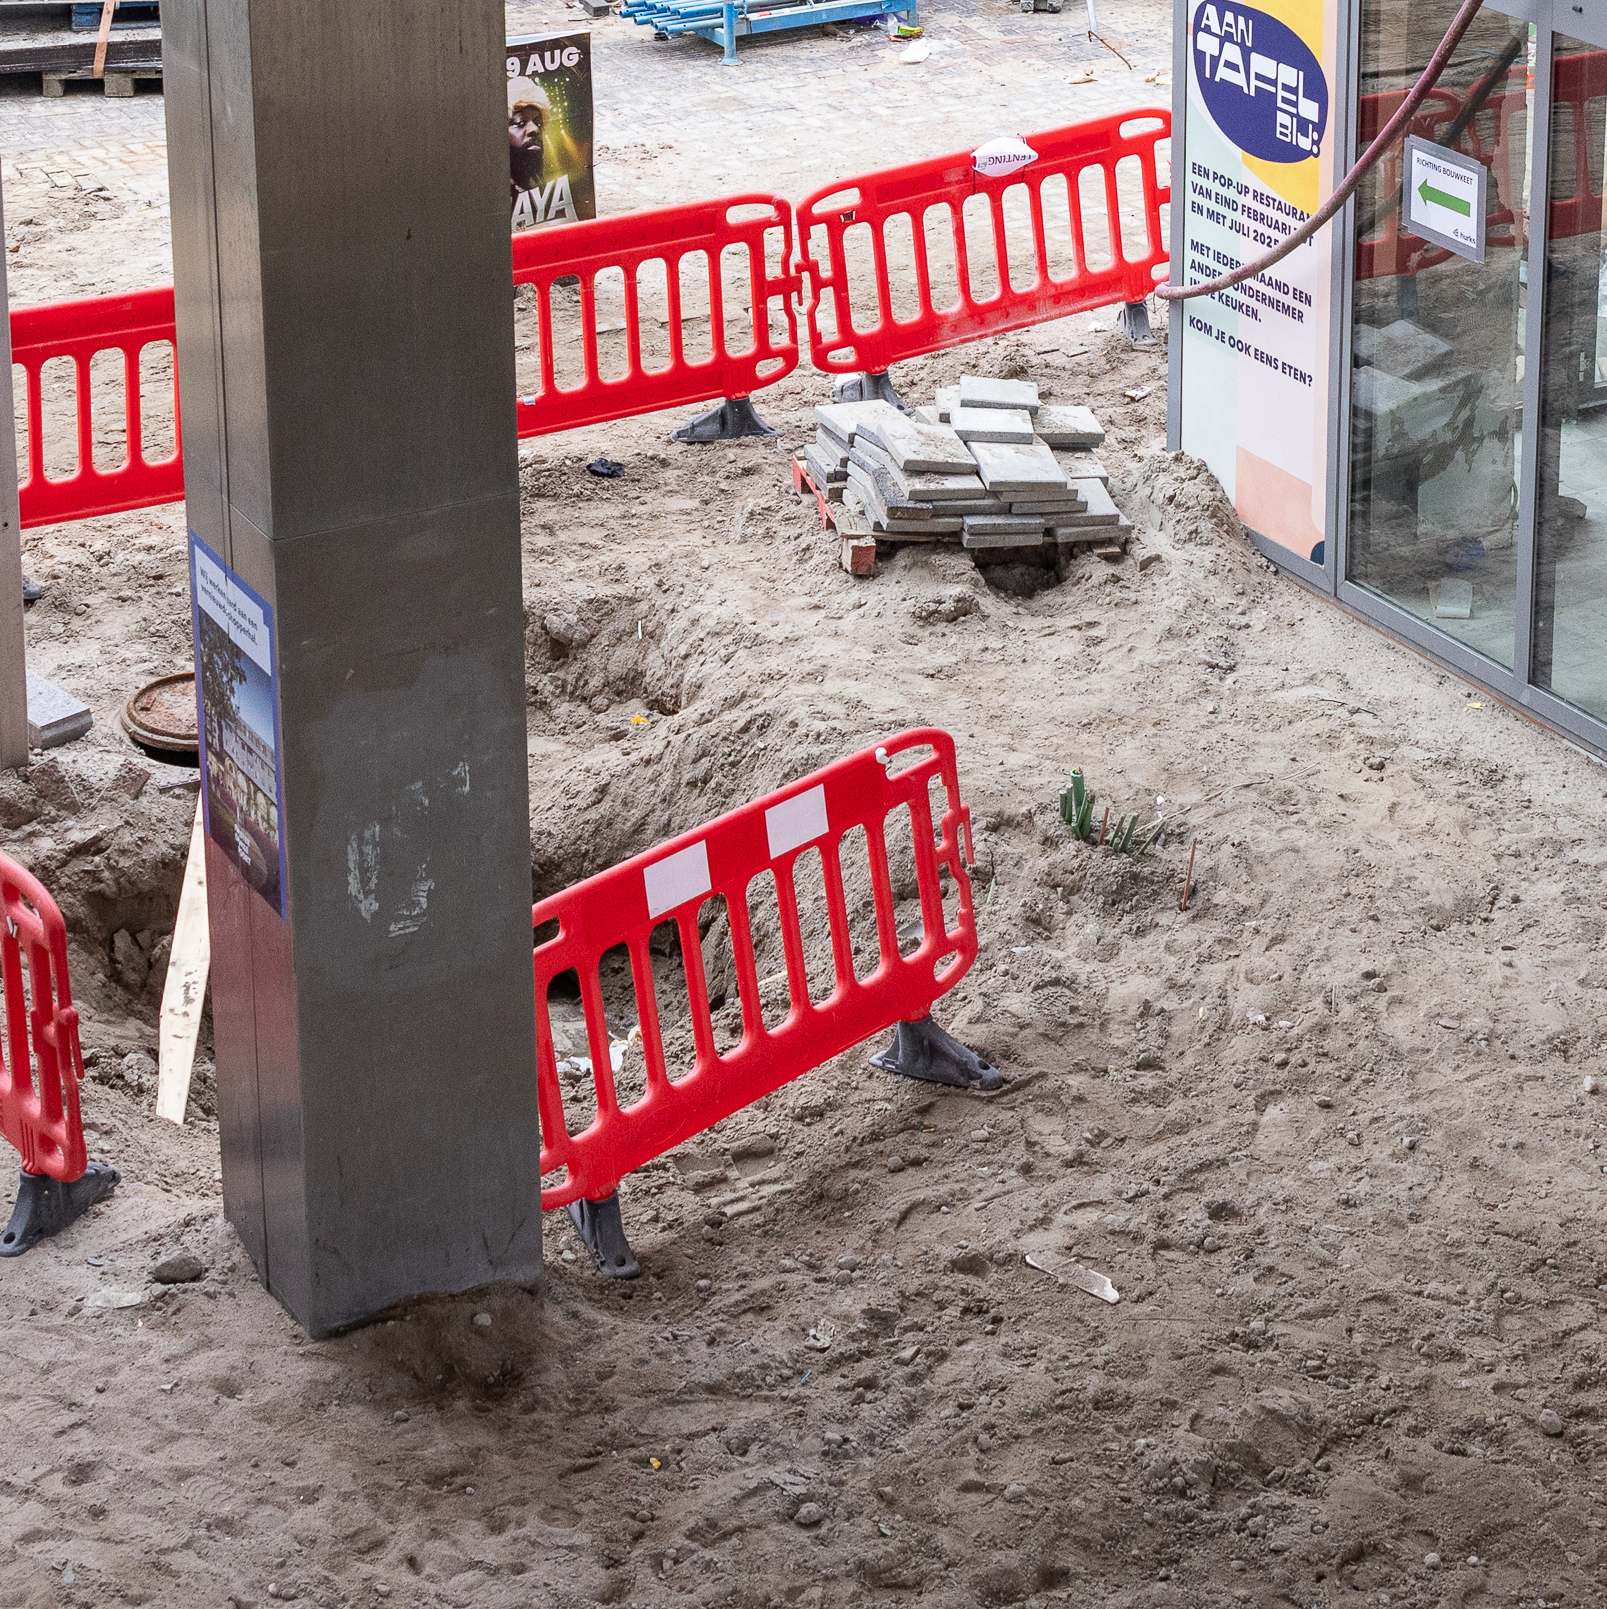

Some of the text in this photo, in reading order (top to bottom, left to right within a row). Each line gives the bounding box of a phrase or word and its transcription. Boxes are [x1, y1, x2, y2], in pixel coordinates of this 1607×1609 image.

[1201, 3, 1252, 48] AAN
[525, 47, 581, 76] AUG
[1196, 31, 1319, 123] TAFEL
[1276, 111, 1319, 154] BIJ:
[1192, 162, 1210, 181] EEN
[1212, 171, 1250, 197] POP-UP
[1416, 157, 1473, 185] RICHTING BOUWKEET
[1191, 180, 1291, 236] VAN EIND FEBRUARI
[1191, 200, 1204, 217] EN
[1207, 207, 1227, 227] MET
[1229, 218, 1250, 238] JULI
[1460, 232, 1476, 244] hurks
[1190, 239, 1211, 259] MET
[1292, 287, 1312, 307] EEN
[1218, 290, 1262, 323] KEUKEN.
[1233, 281, 1304, 324] ONDERNEMER
[1189, 314, 1313, 388] KOM JE OOK EENS ETEN?
